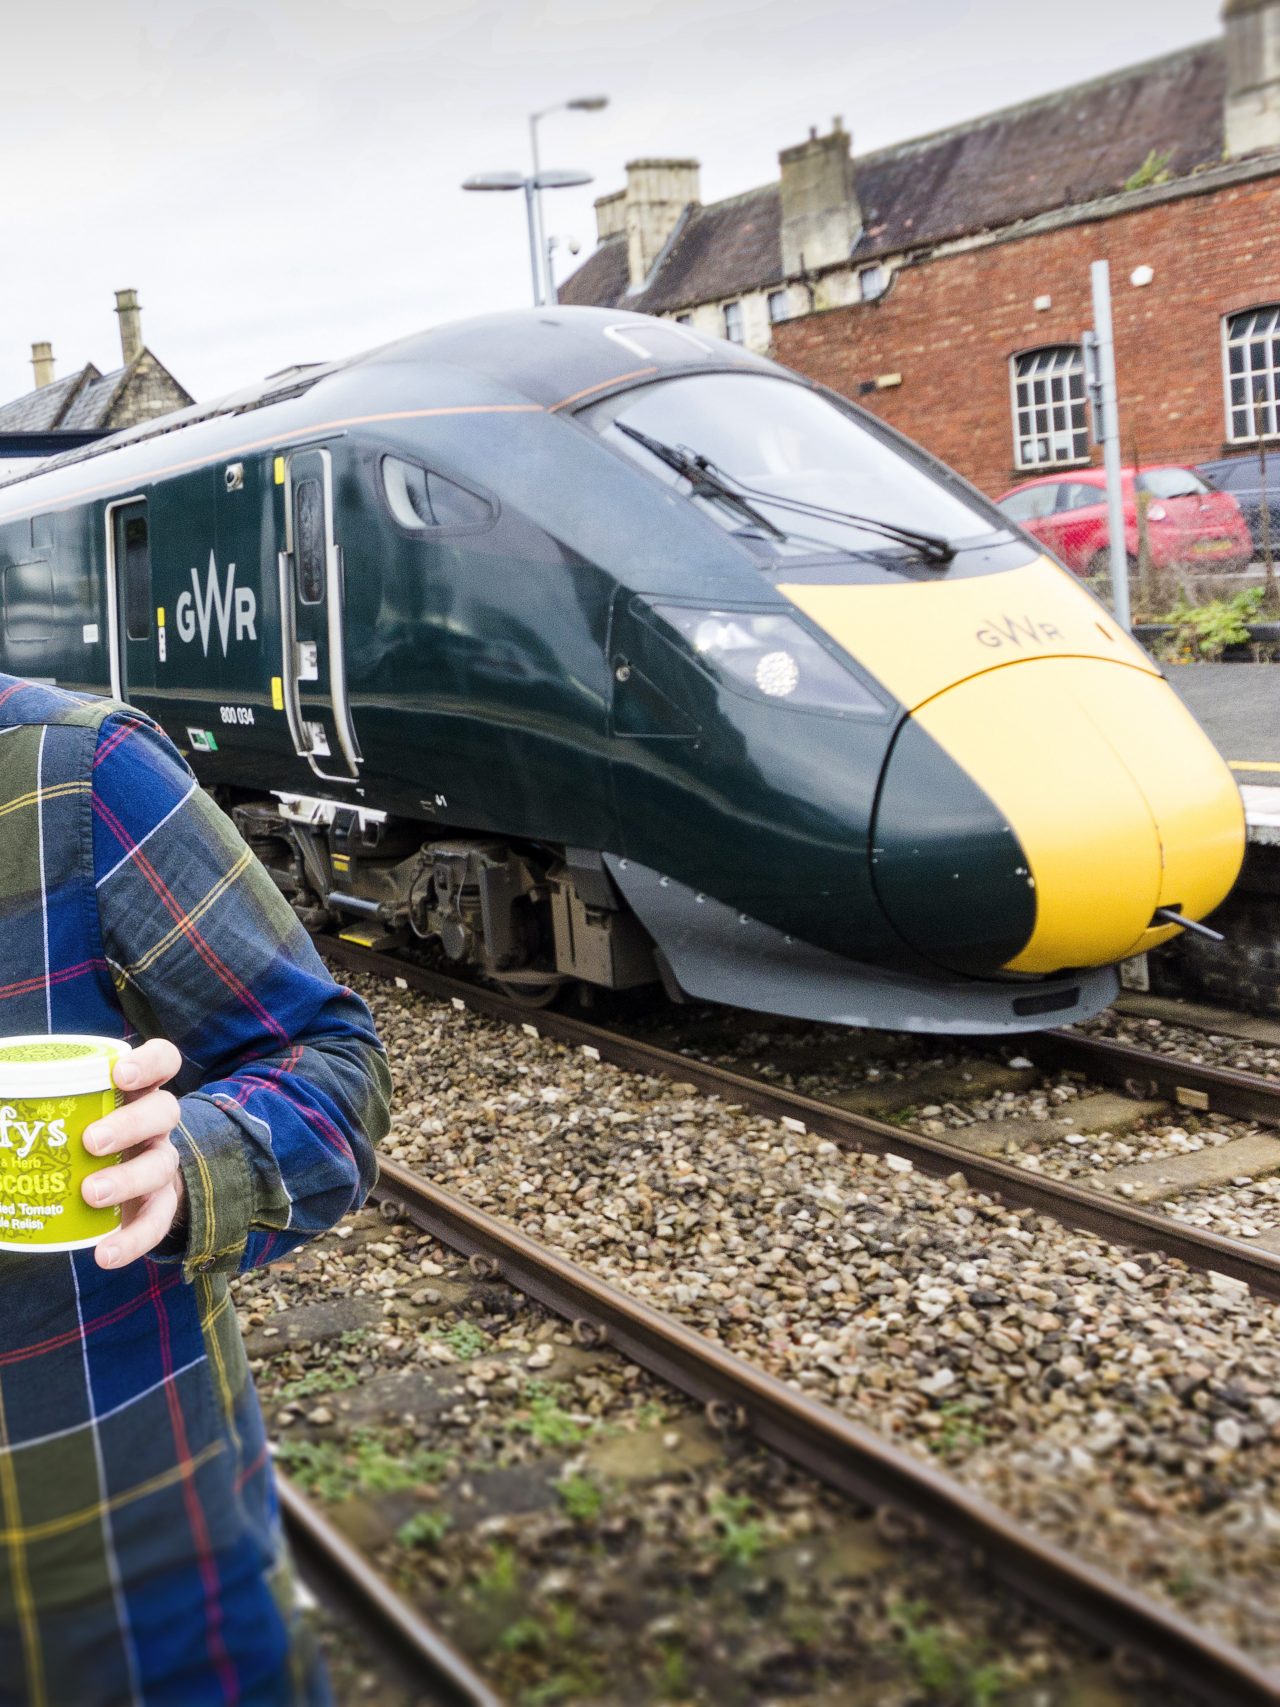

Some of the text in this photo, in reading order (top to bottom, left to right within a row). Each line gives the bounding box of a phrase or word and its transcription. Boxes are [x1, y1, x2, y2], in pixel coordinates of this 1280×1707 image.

[176, 548, 257, 658] GWR
[976, 613, 1065, 648] GWR
[220, 706, 254, 725] 800 034
[12, 1157, 41, 1169] Herb
[18, 1203, 64, 1216] Tomato
[11, 1218, 44, 1230] Relish
